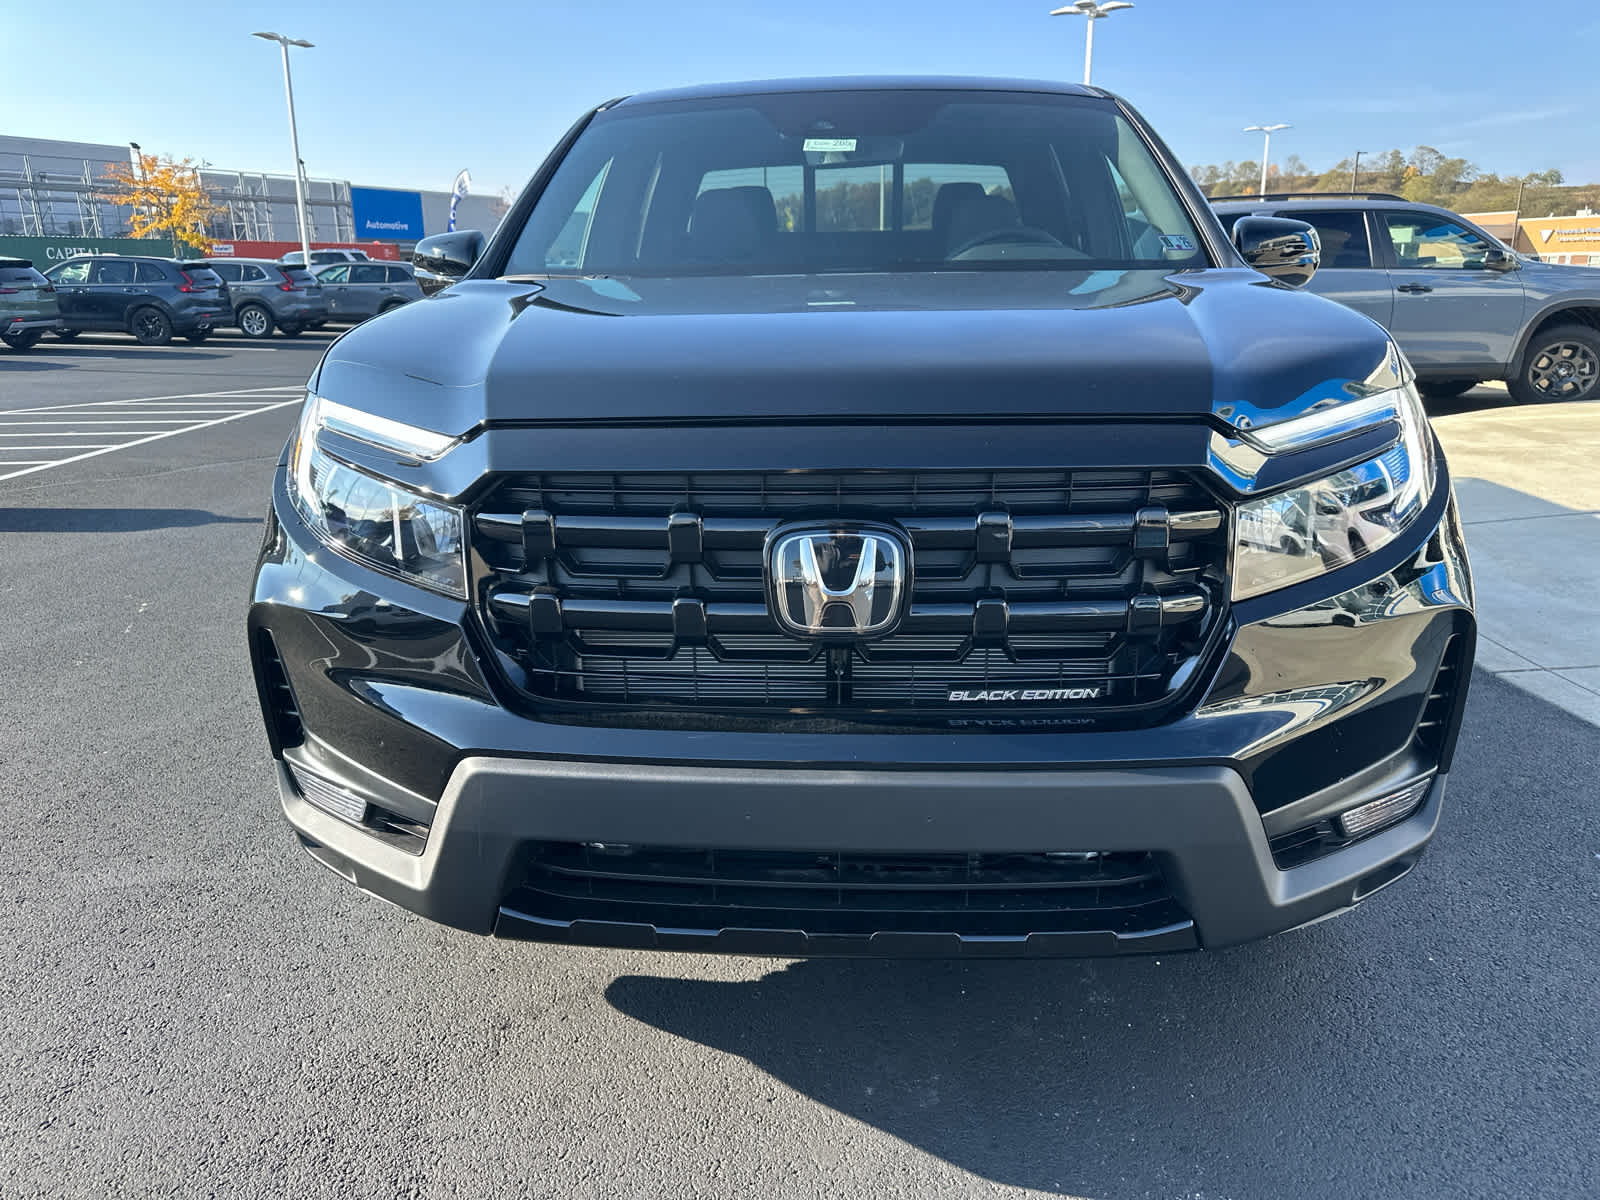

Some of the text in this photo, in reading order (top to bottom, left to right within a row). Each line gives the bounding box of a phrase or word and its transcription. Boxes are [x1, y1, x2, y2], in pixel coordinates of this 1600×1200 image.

[366, 219, 409, 231] Automotive
[948, 687, 1099, 701] BLACK EDITION
